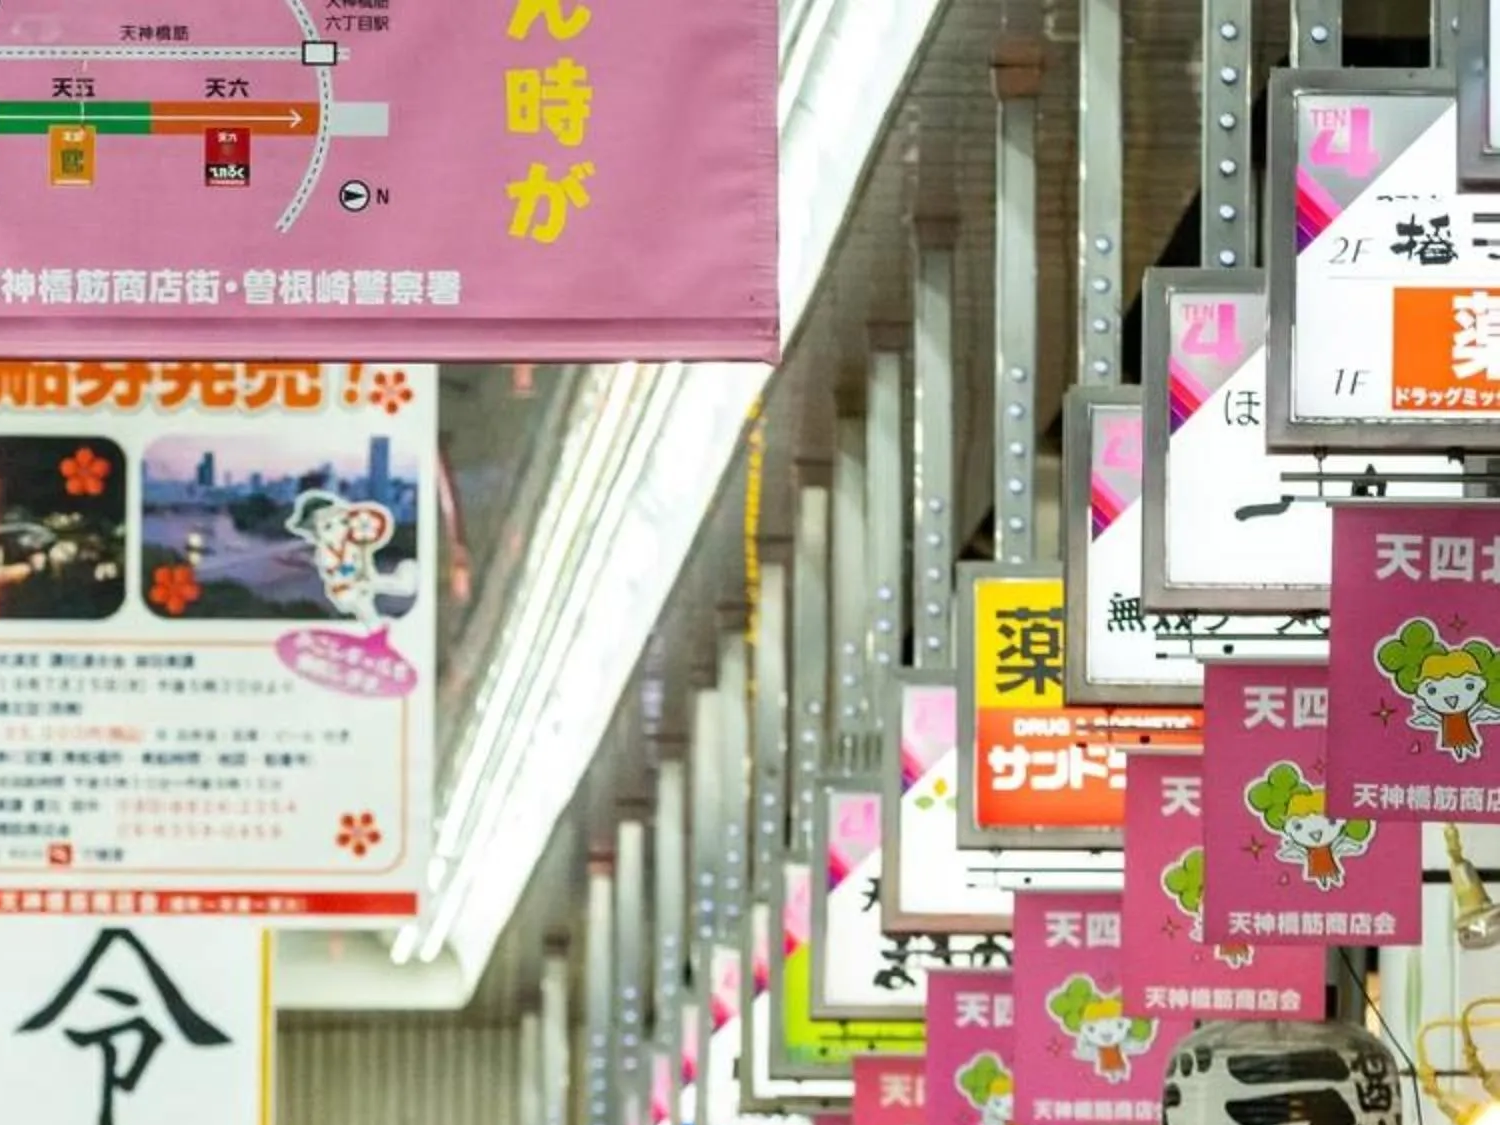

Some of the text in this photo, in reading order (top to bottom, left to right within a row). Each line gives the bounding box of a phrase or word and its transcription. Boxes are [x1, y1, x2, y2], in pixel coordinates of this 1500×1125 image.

[120, 25, 190, 42] 天神橋筋
[325, 16, 389, 32] 六丁目駅
[205, 78, 250, 98] 天六
[1310, 108, 1347, 127] TEN
[376, 188, 390, 204] N
[1328, 236, 1374, 264] 2F
[1332, 369, 1370, 396] 1F
[1228, 911, 1397, 937] 天神橋筋商店会
[1144, 987, 1302, 1012] 天神橋筋商店会
